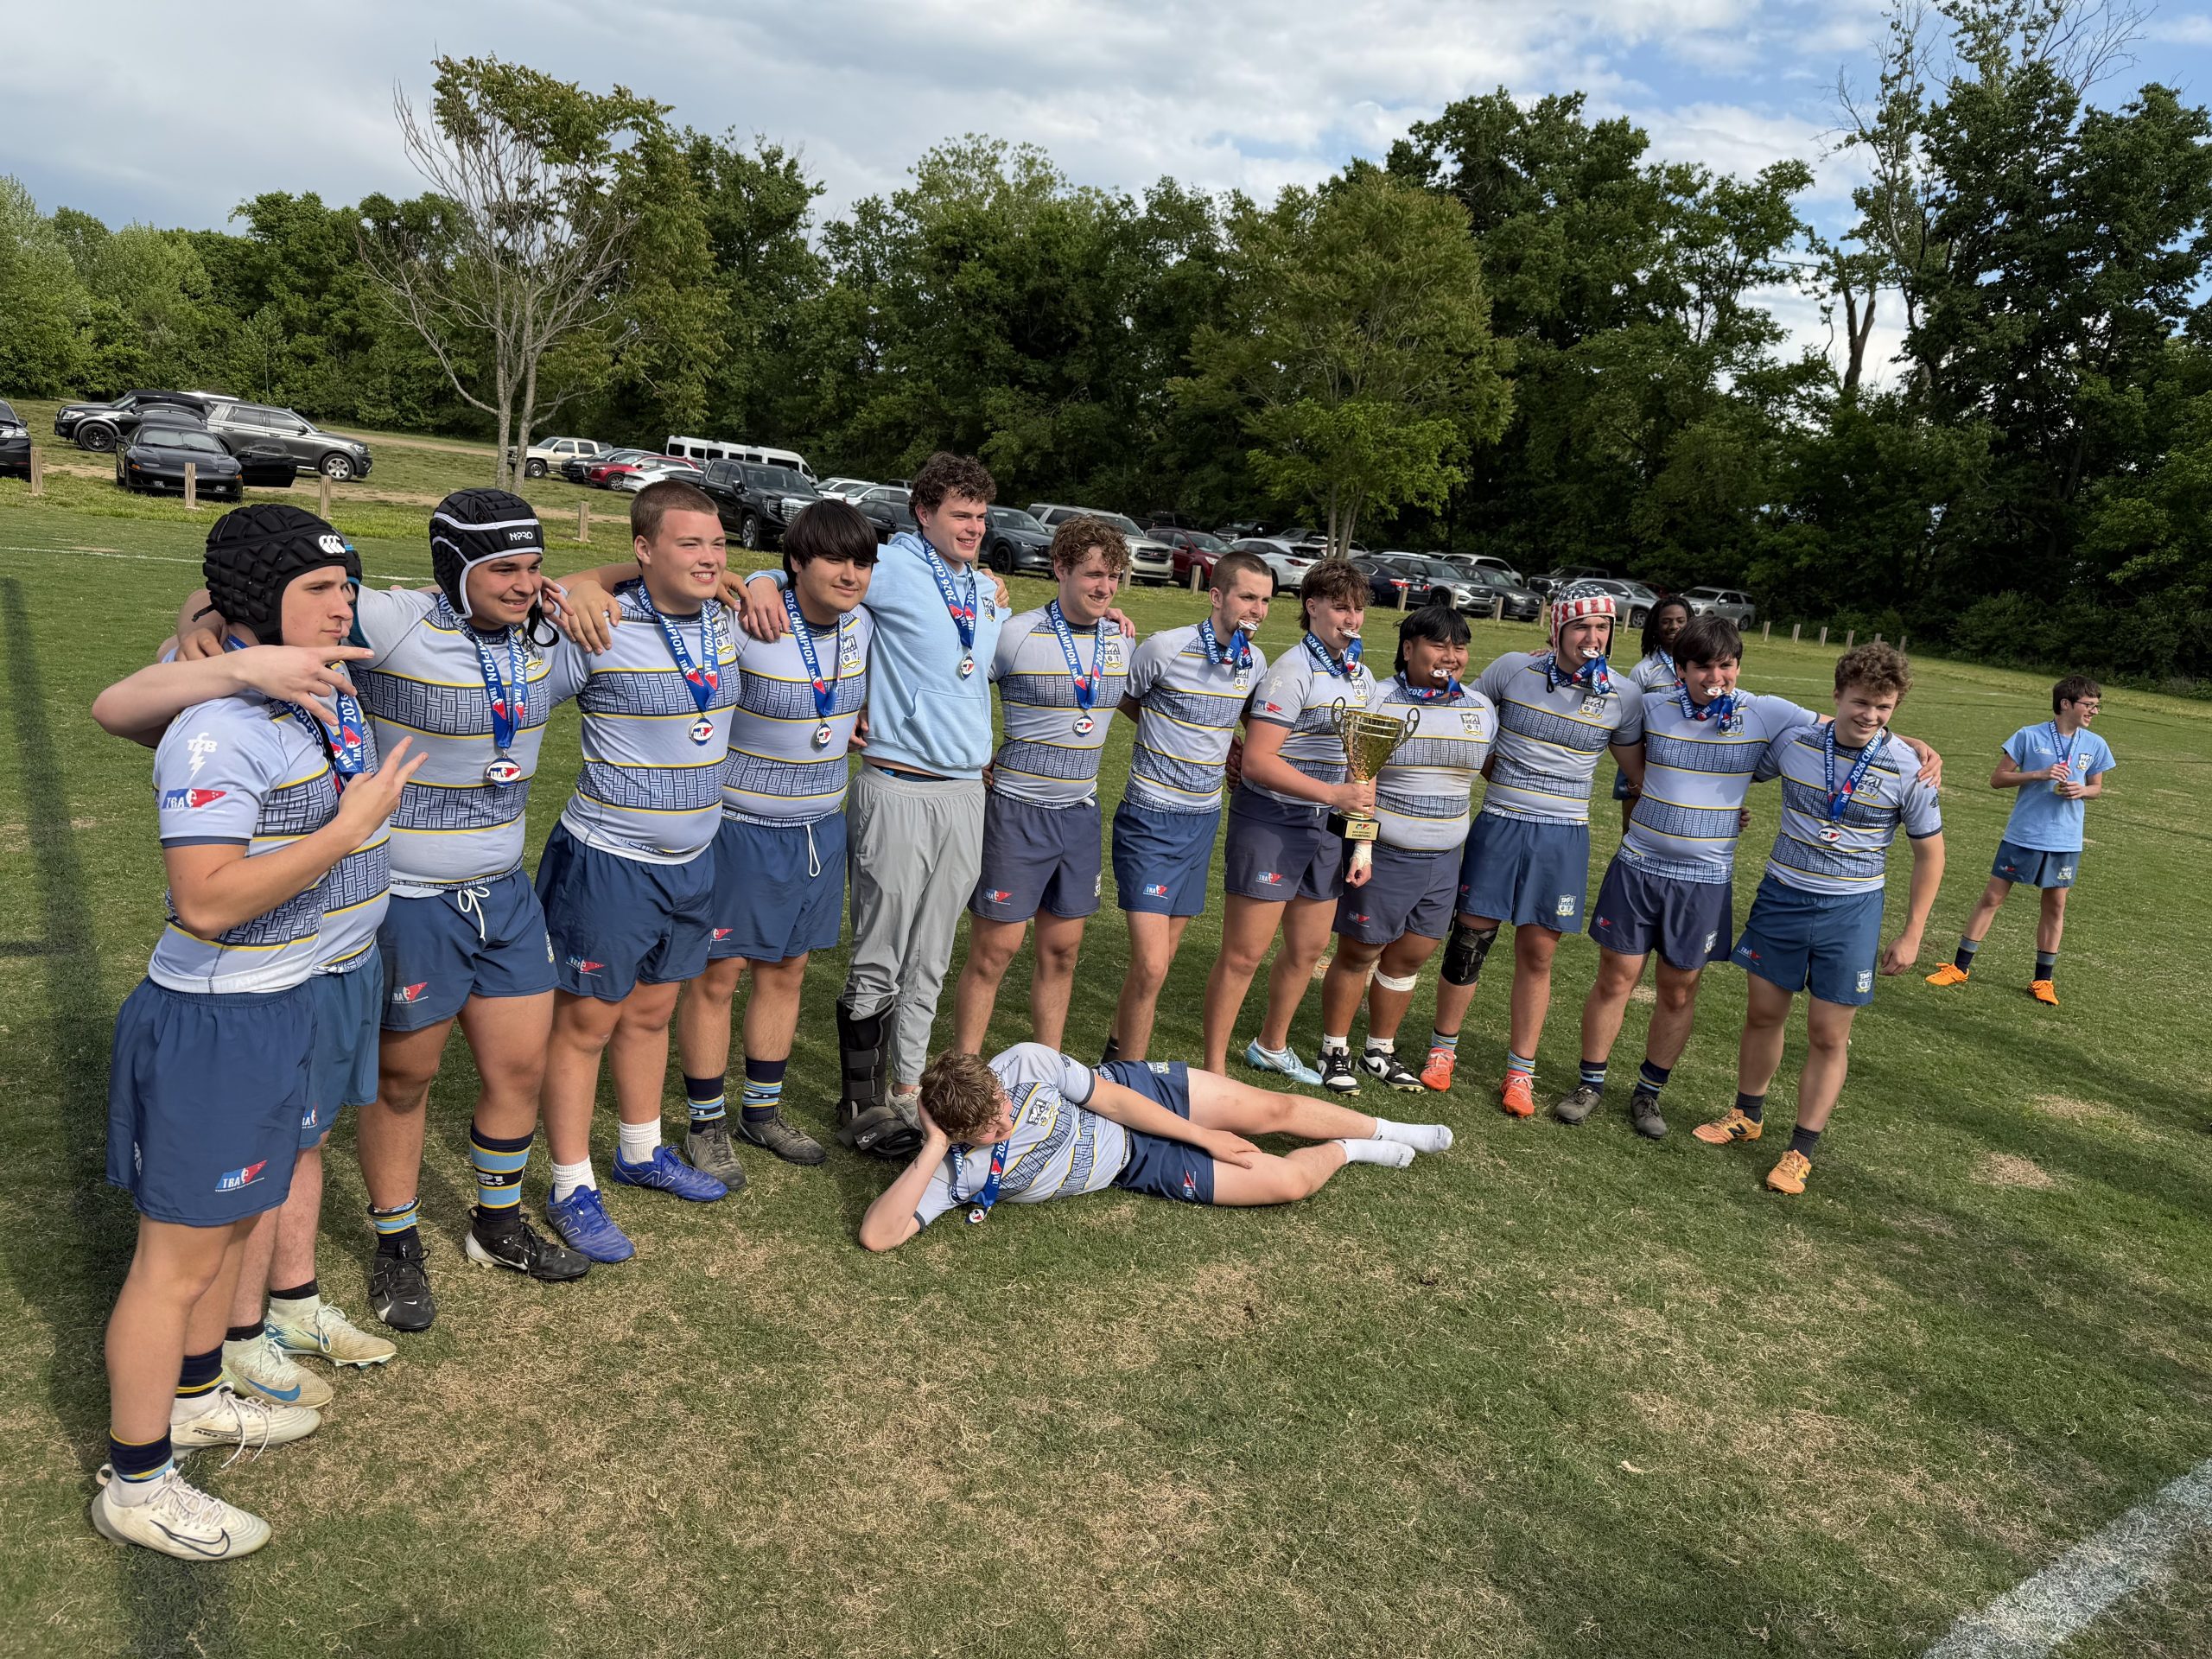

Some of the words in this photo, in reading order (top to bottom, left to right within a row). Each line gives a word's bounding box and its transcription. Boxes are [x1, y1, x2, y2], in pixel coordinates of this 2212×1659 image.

[940, 577, 957, 601] 2026
[790, 611, 816, 664] CHAMPION
[1055, 620, 1077, 664] CHAMPION
[678, 658, 692, 676] TRA
[1095, 645, 1104, 667] 2026
[1316, 646, 1342, 676] CHAMPIO
[489, 684, 500, 702] TRA
[1850, 760, 1866, 783] 2026
[166, 796, 186, 809] TRA
[222, 1176, 241, 1189] TRA
